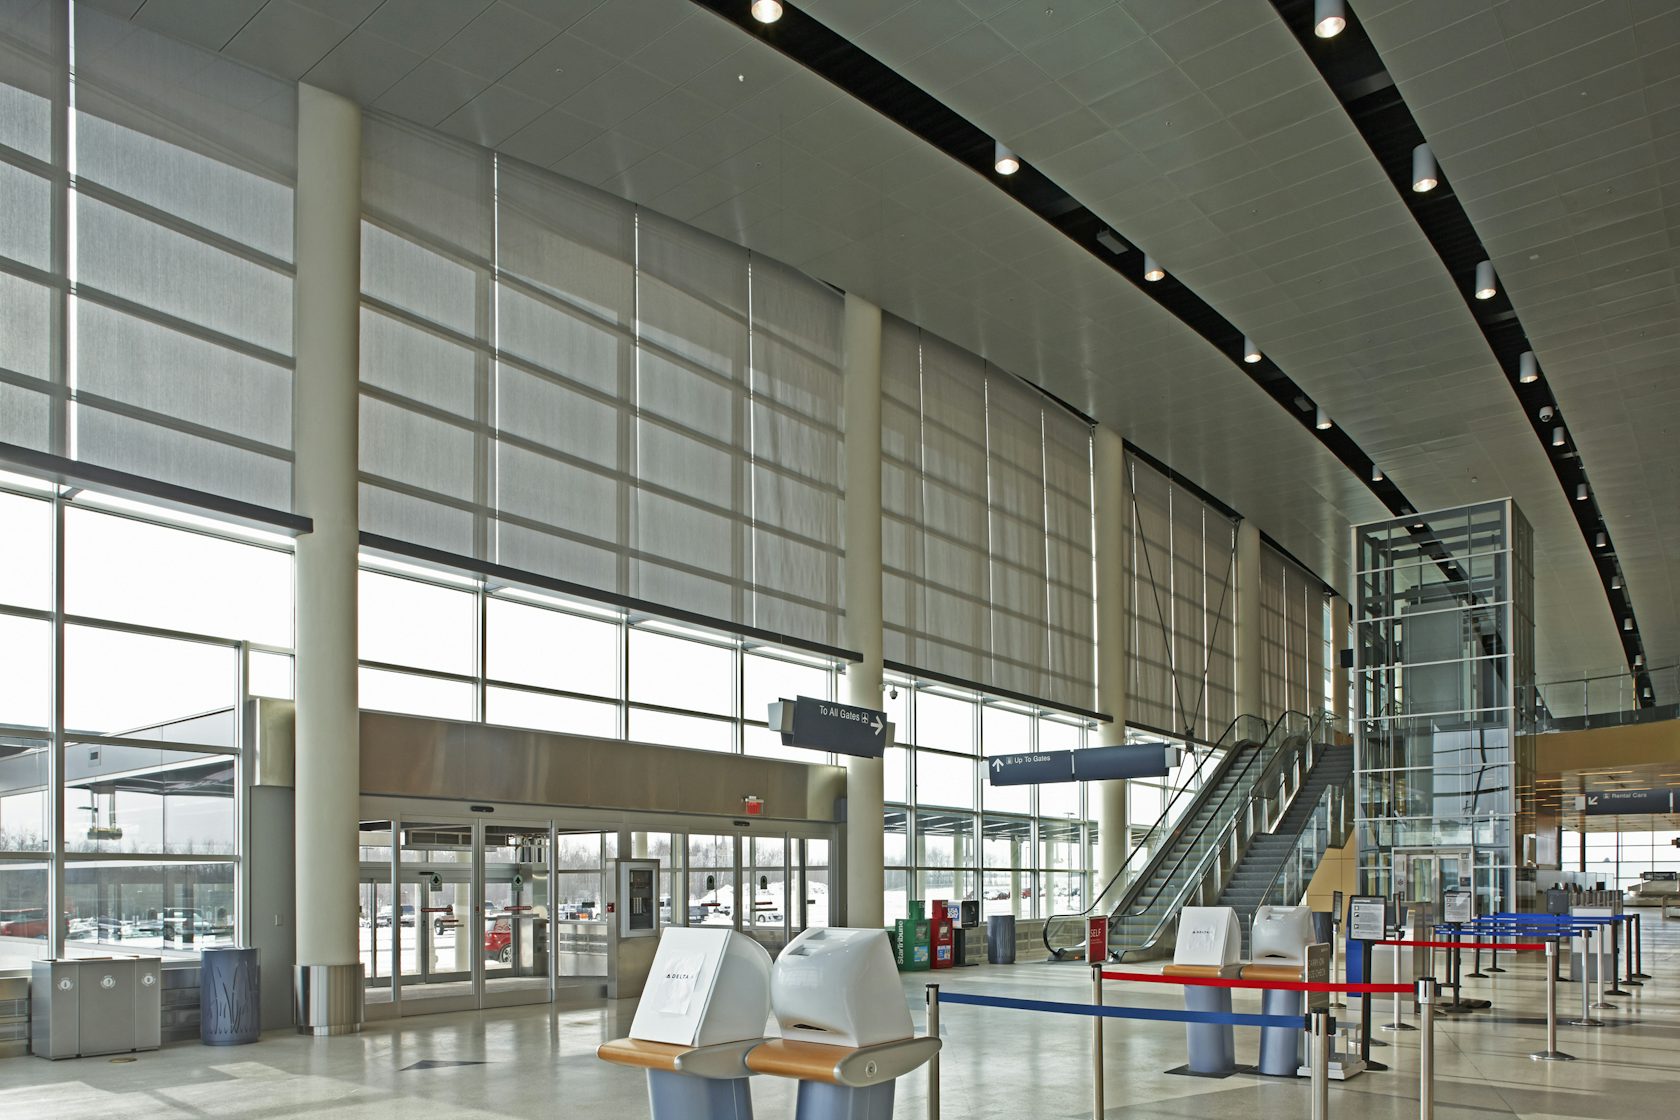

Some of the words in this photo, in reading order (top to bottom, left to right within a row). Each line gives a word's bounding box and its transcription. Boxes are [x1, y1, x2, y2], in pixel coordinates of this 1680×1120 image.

[819, 705, 828, 715] To
[829, 707, 839, 717] All
[840, 709, 860, 722] Gates
[1014, 757, 1023, 765] Up
[1033, 755, 1051, 763] Gates
[1090, 928, 1102, 938] SELF
